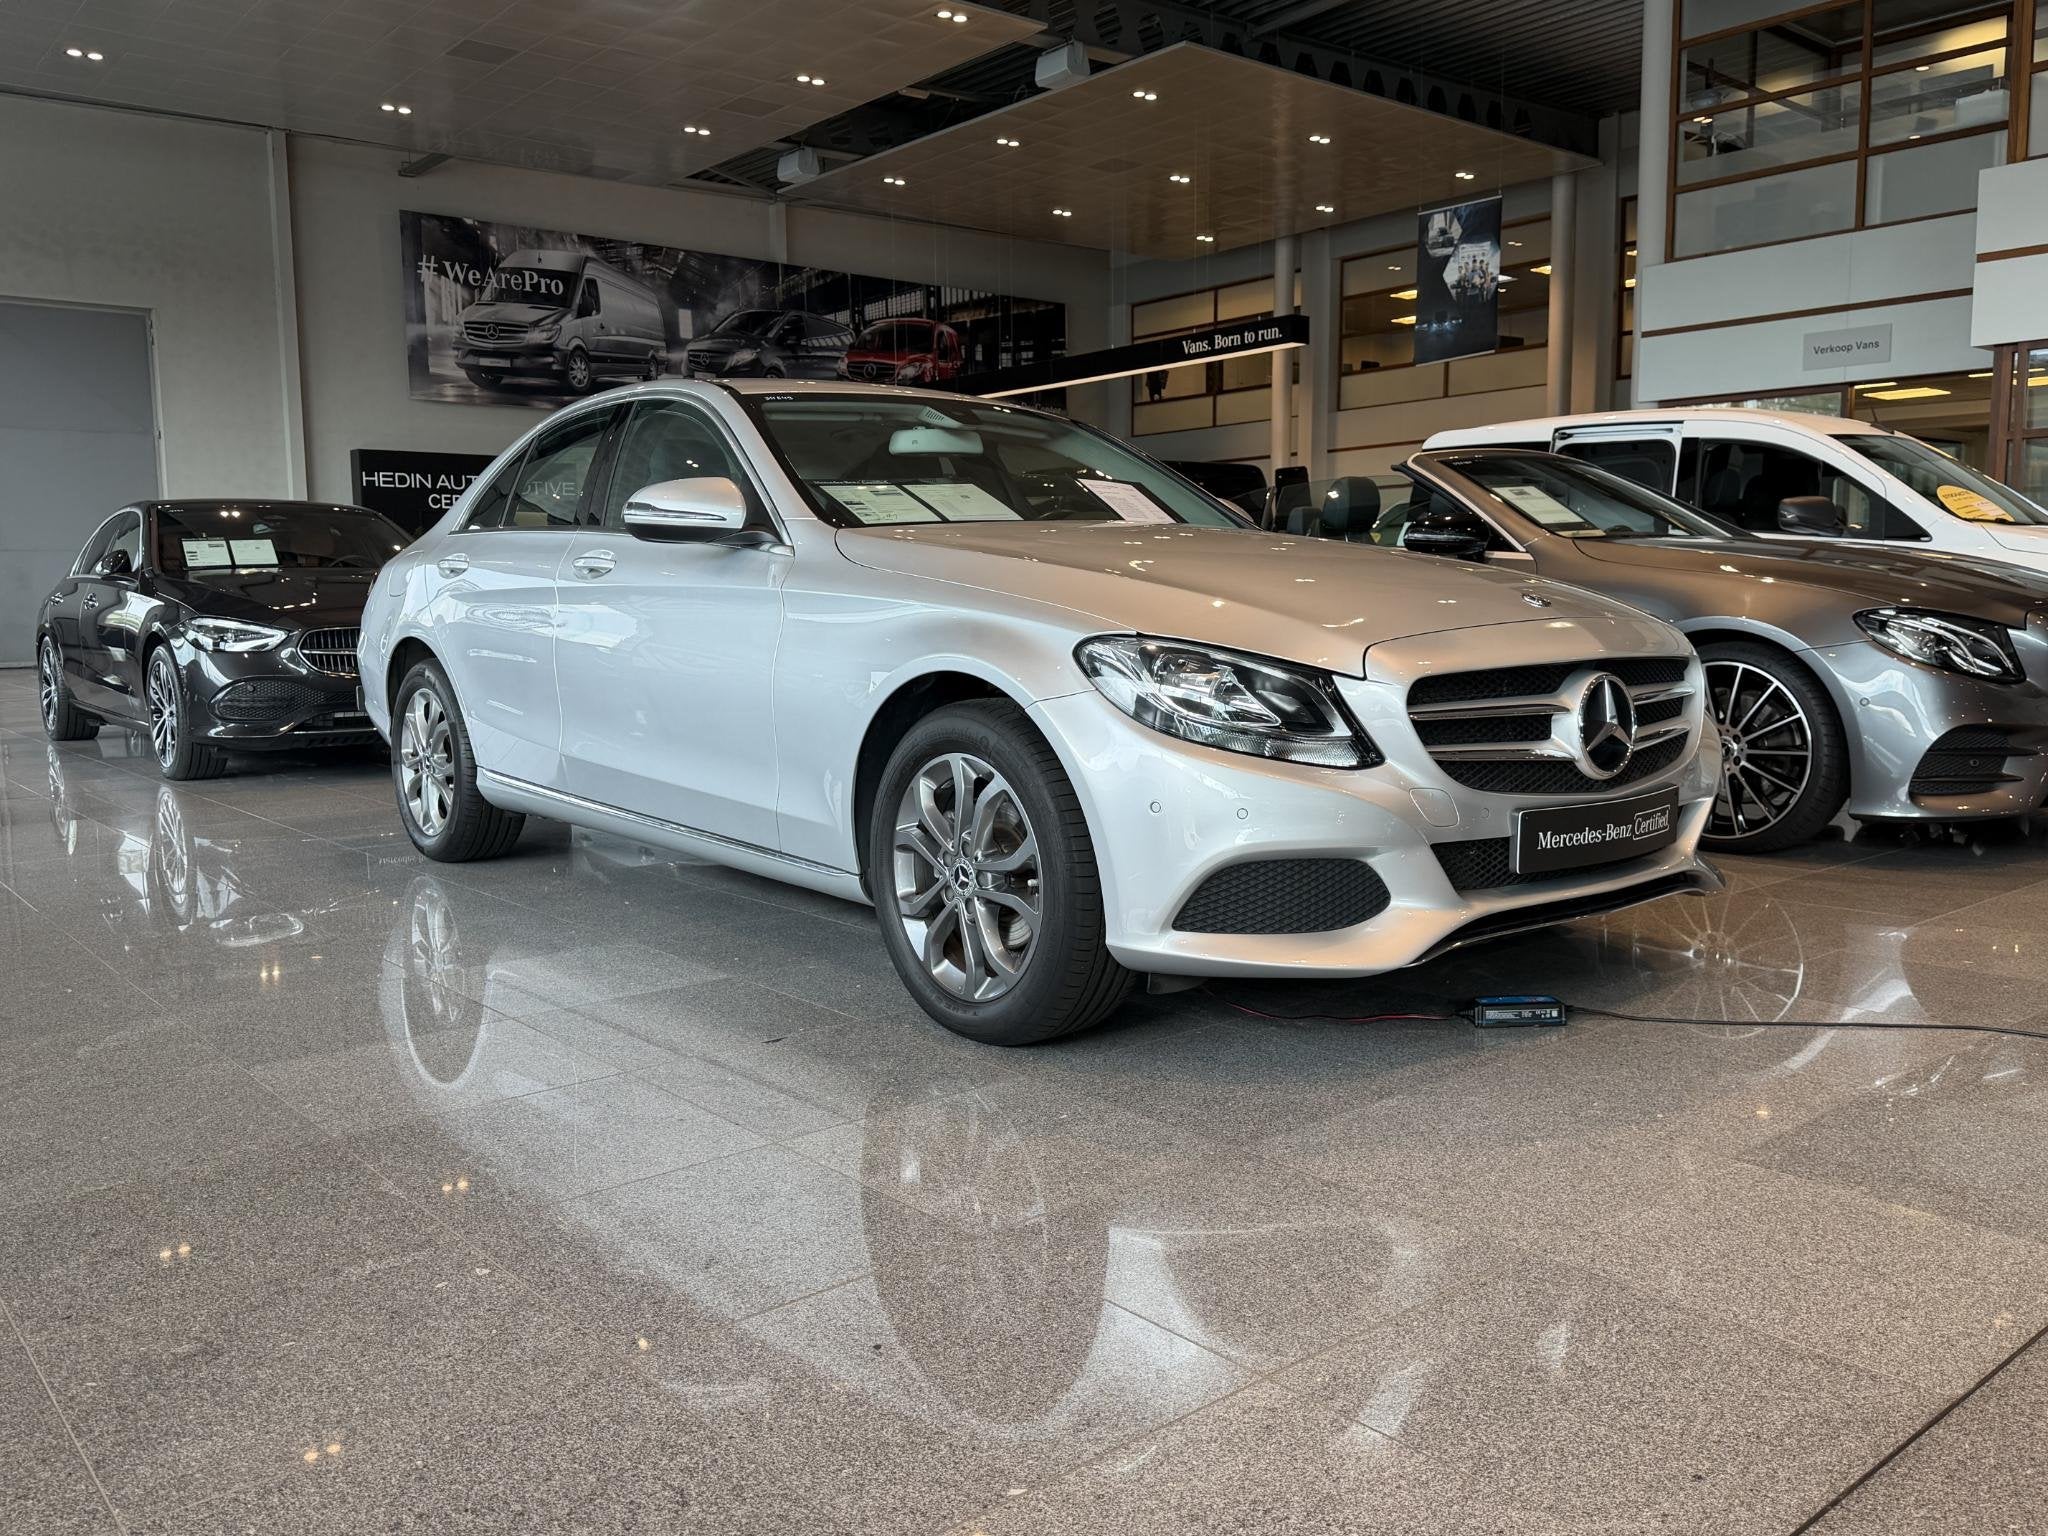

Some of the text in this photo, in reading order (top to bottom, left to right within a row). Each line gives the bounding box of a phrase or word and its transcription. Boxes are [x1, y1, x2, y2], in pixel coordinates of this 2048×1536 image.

[1182, 327, 1283, 355] Vans. Born to run.
[1813, 341, 1880, 355] Verkoop Vans
[362, 471, 432, 489] HEDIN
[1537, 810, 1669, 850] Mercedes-Benz Certified
